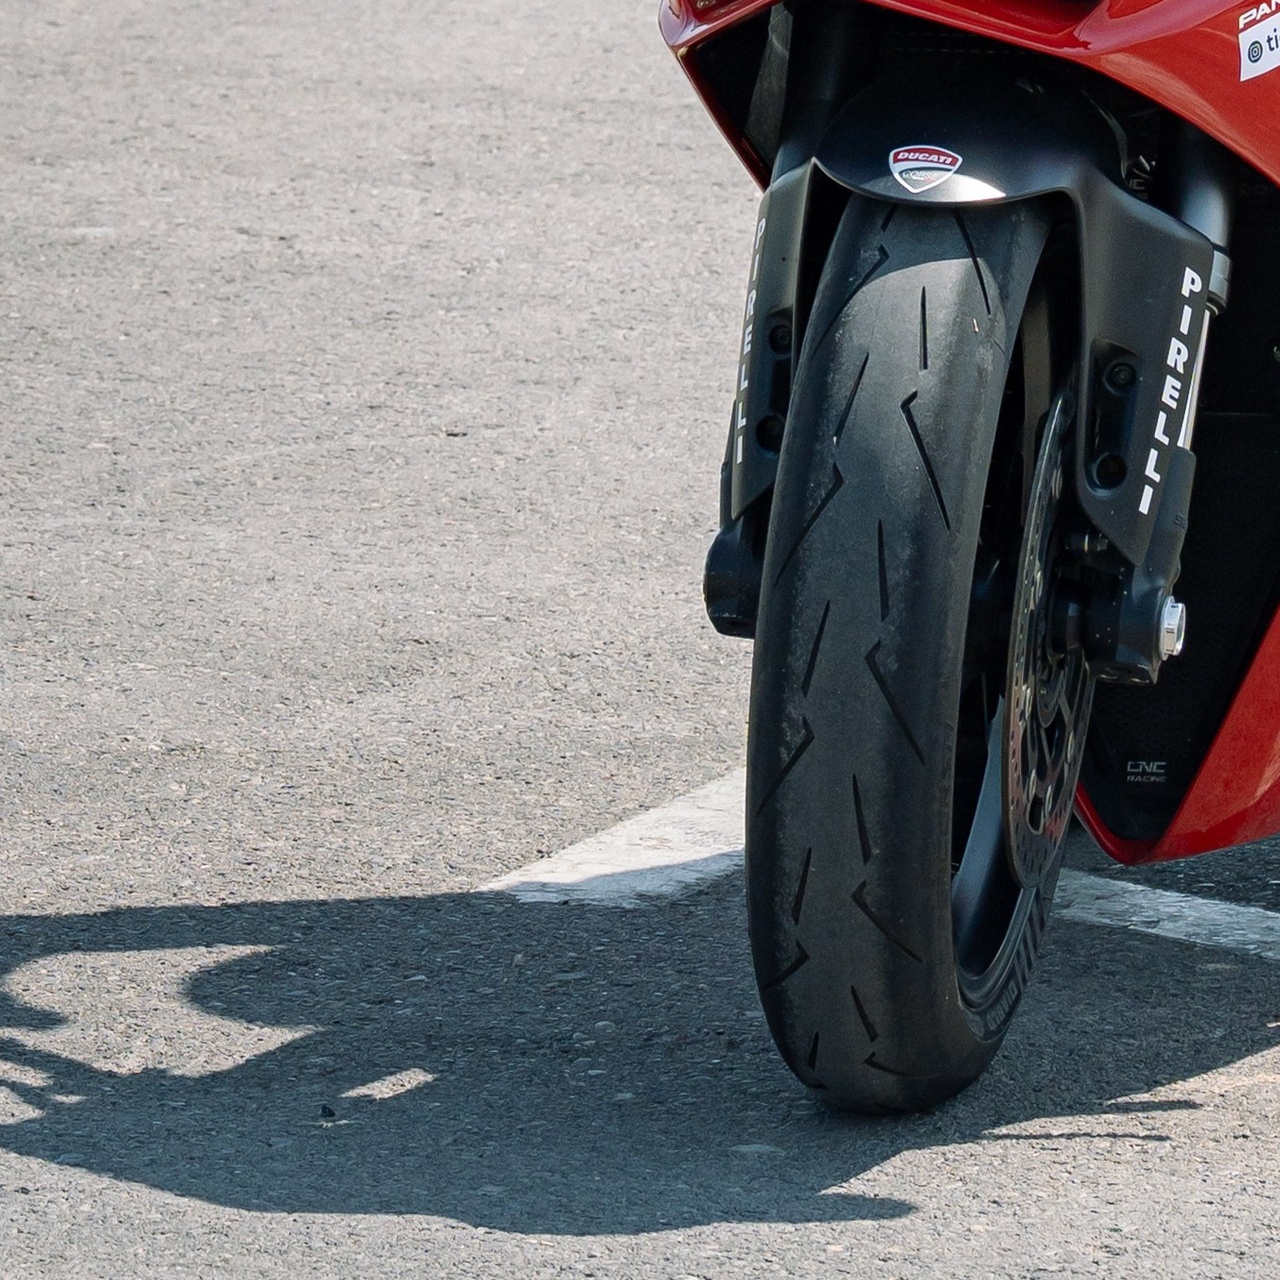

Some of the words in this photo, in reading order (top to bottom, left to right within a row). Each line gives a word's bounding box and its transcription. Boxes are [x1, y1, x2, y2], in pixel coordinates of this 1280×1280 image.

[897, 151, 953, 164] DUCATI
[736, 217, 767, 465] PIRELLI
[1138, 266, 1203, 516] PIRELLI
[1126, 761, 1167, 773] CNC
